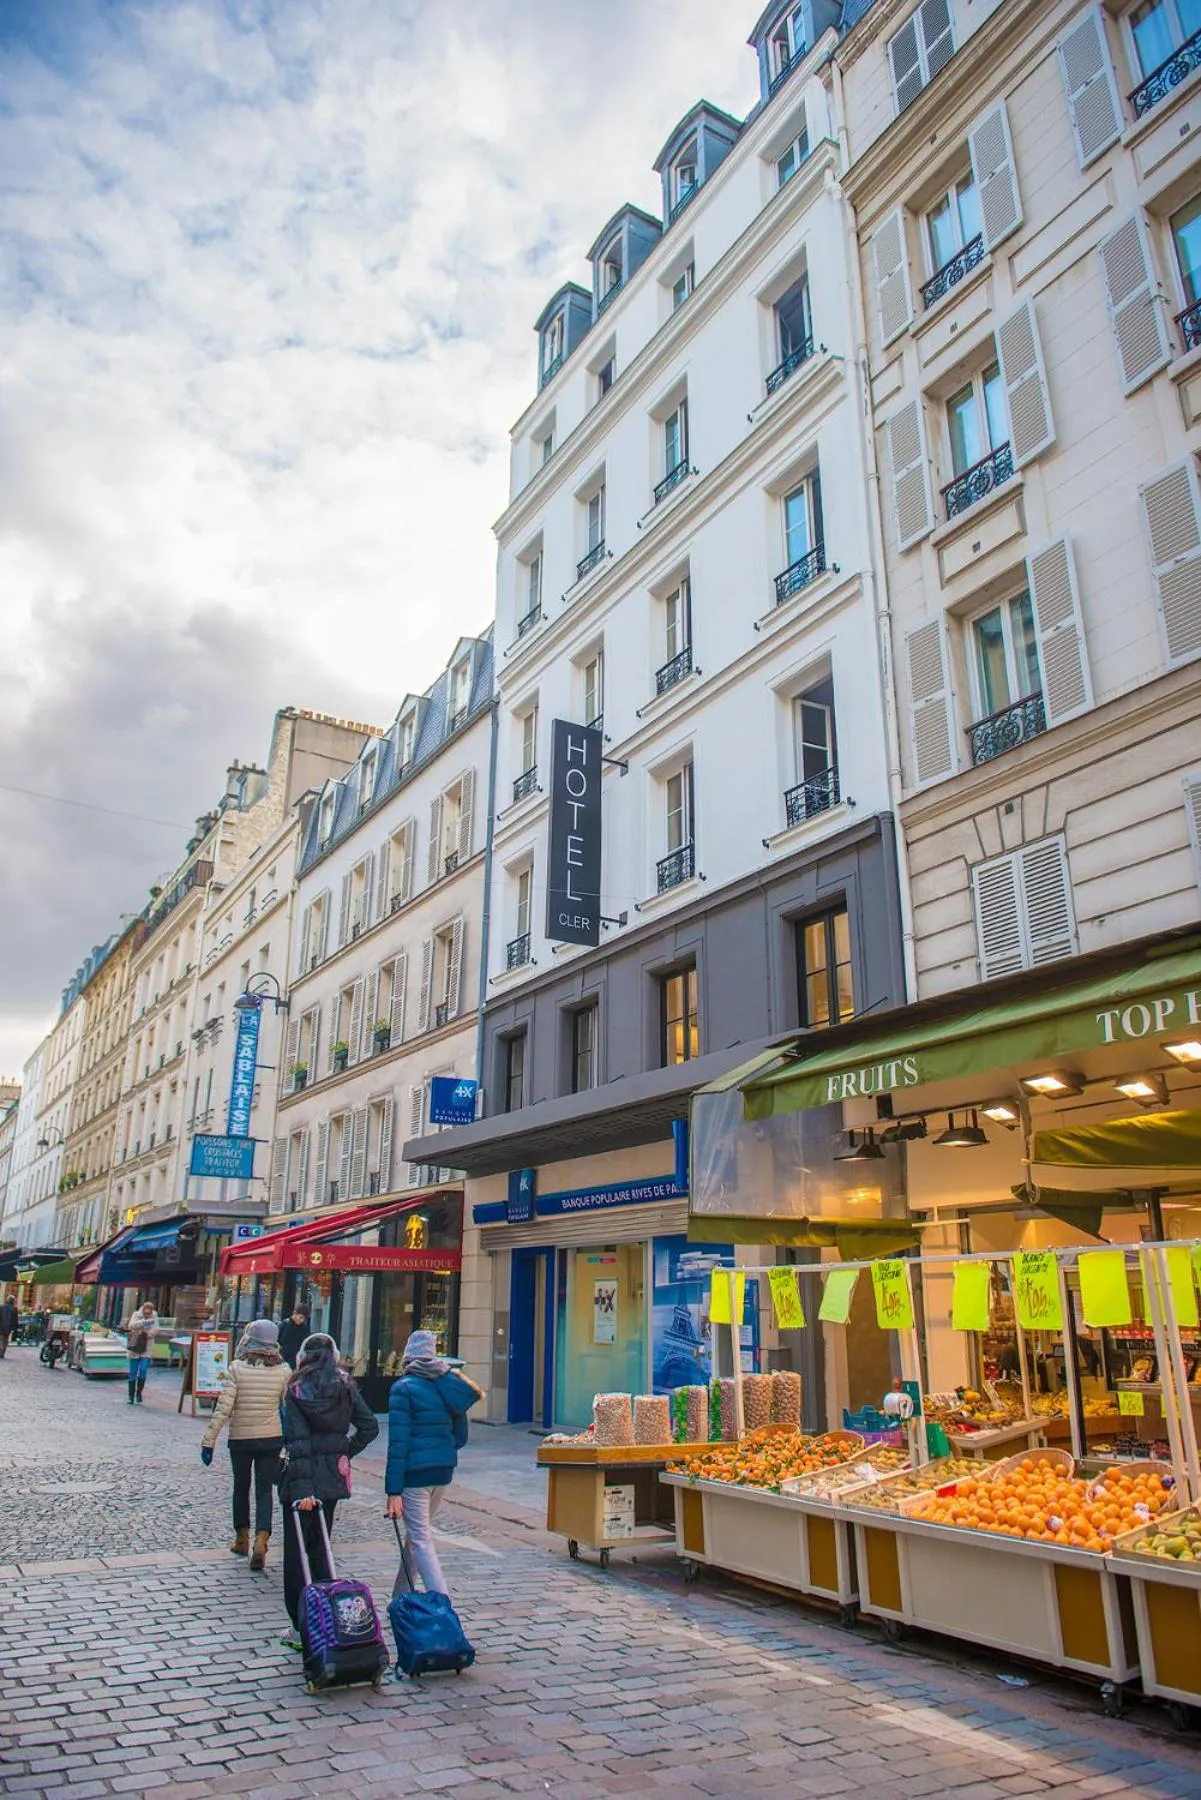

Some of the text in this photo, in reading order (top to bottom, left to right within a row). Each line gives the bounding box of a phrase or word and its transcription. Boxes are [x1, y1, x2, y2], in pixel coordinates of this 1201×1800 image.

[566, 735, 587, 901] HOTEL
[558, 913, 590, 931] CLER
[241, 1014, 259, 1027] LA
[1095, 997, 1176, 1044] TOP
[230, 1034, 257, 1136] SABLAISE
[825, 1056, 919, 1101] FRUITS
[561, 1196, 590, 1210] BANQUE
[590, 1190, 631, 1205] POPULAIRE
[631, 1186, 653, 1201] RIVES
[653, 1184, 666, 1197] DE
[350, 1256, 454, 1270] TRAITEUR ASIATIQUE
